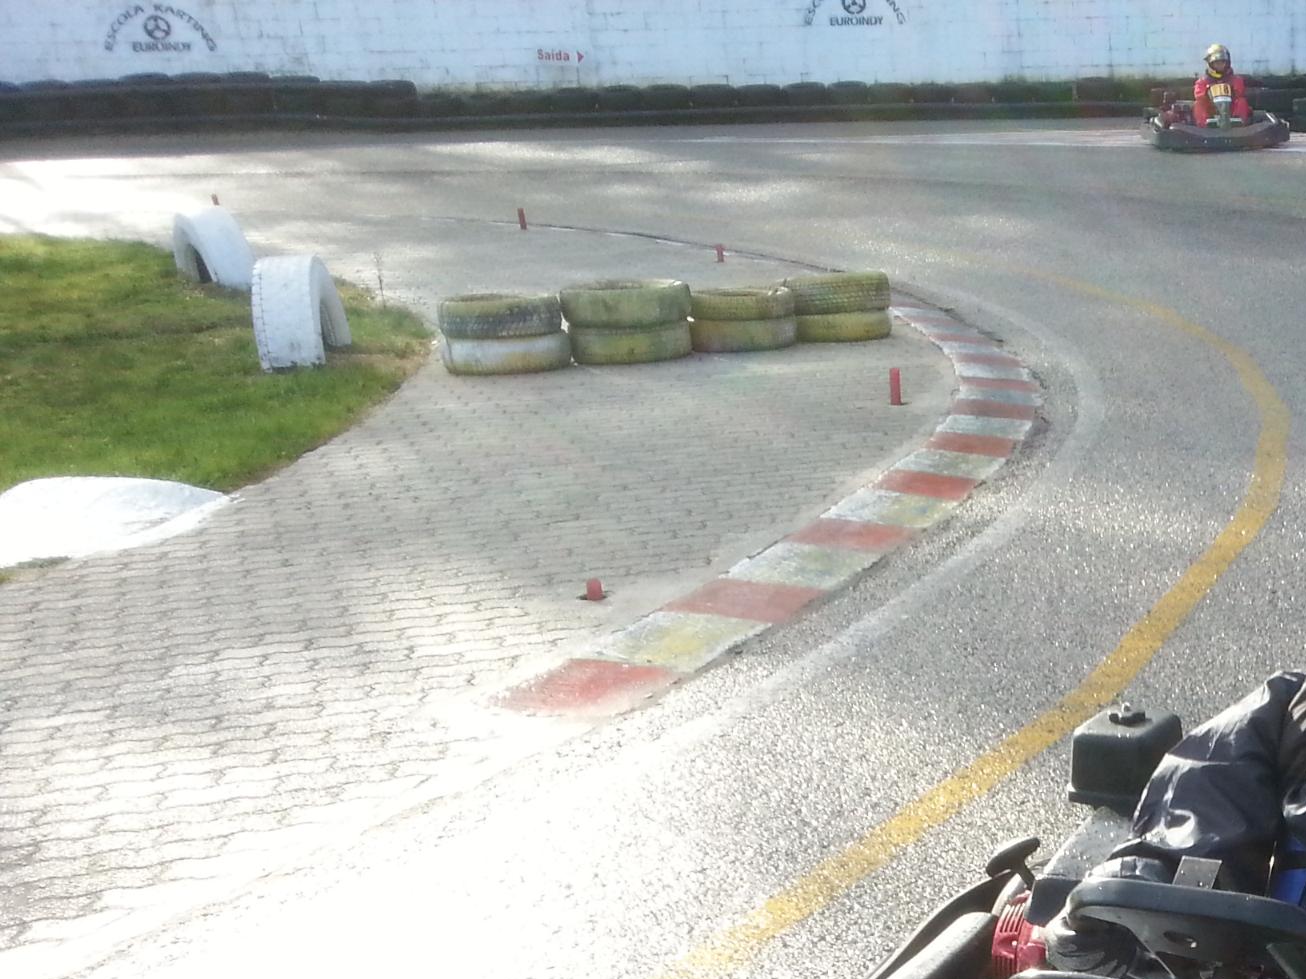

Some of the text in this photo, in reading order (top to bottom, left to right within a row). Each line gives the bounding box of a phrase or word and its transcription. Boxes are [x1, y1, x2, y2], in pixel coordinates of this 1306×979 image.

[829, 16, 884, 27] EUROINDY
[104, 4, 217, 52] ESCOLA KARTING
[131, 40, 191, 52] EUROINDY
